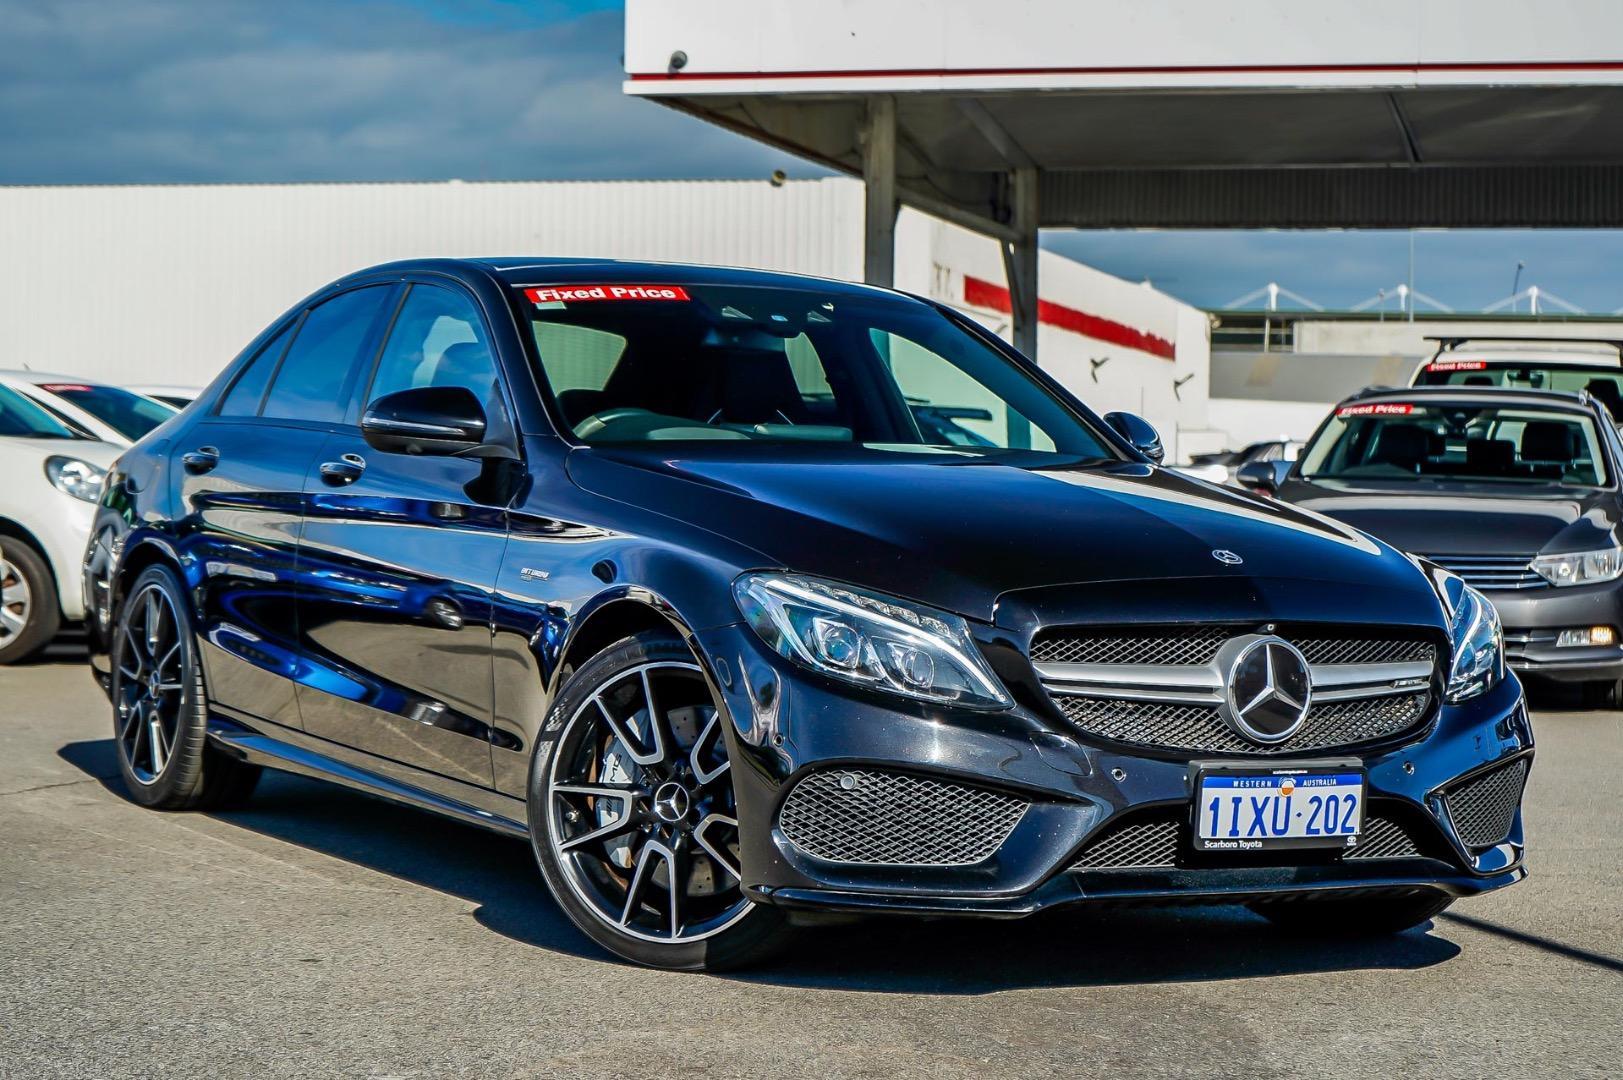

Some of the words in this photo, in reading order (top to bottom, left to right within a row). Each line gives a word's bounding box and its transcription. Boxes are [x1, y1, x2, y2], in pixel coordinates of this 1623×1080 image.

[536, 287, 606, 301] Fixed
[610, 286, 676, 299] Price
[1341, 406, 1374, 415] Fixed
[1375, 404, 1406, 414] Price
[1233, 780, 1272, 788] WESTERN
[1303, 779, 1337, 787] AUSTRALIA
[1204, 840, 1238, 849] Scarboro
[1239, 840, 1263, 850] Toyota
